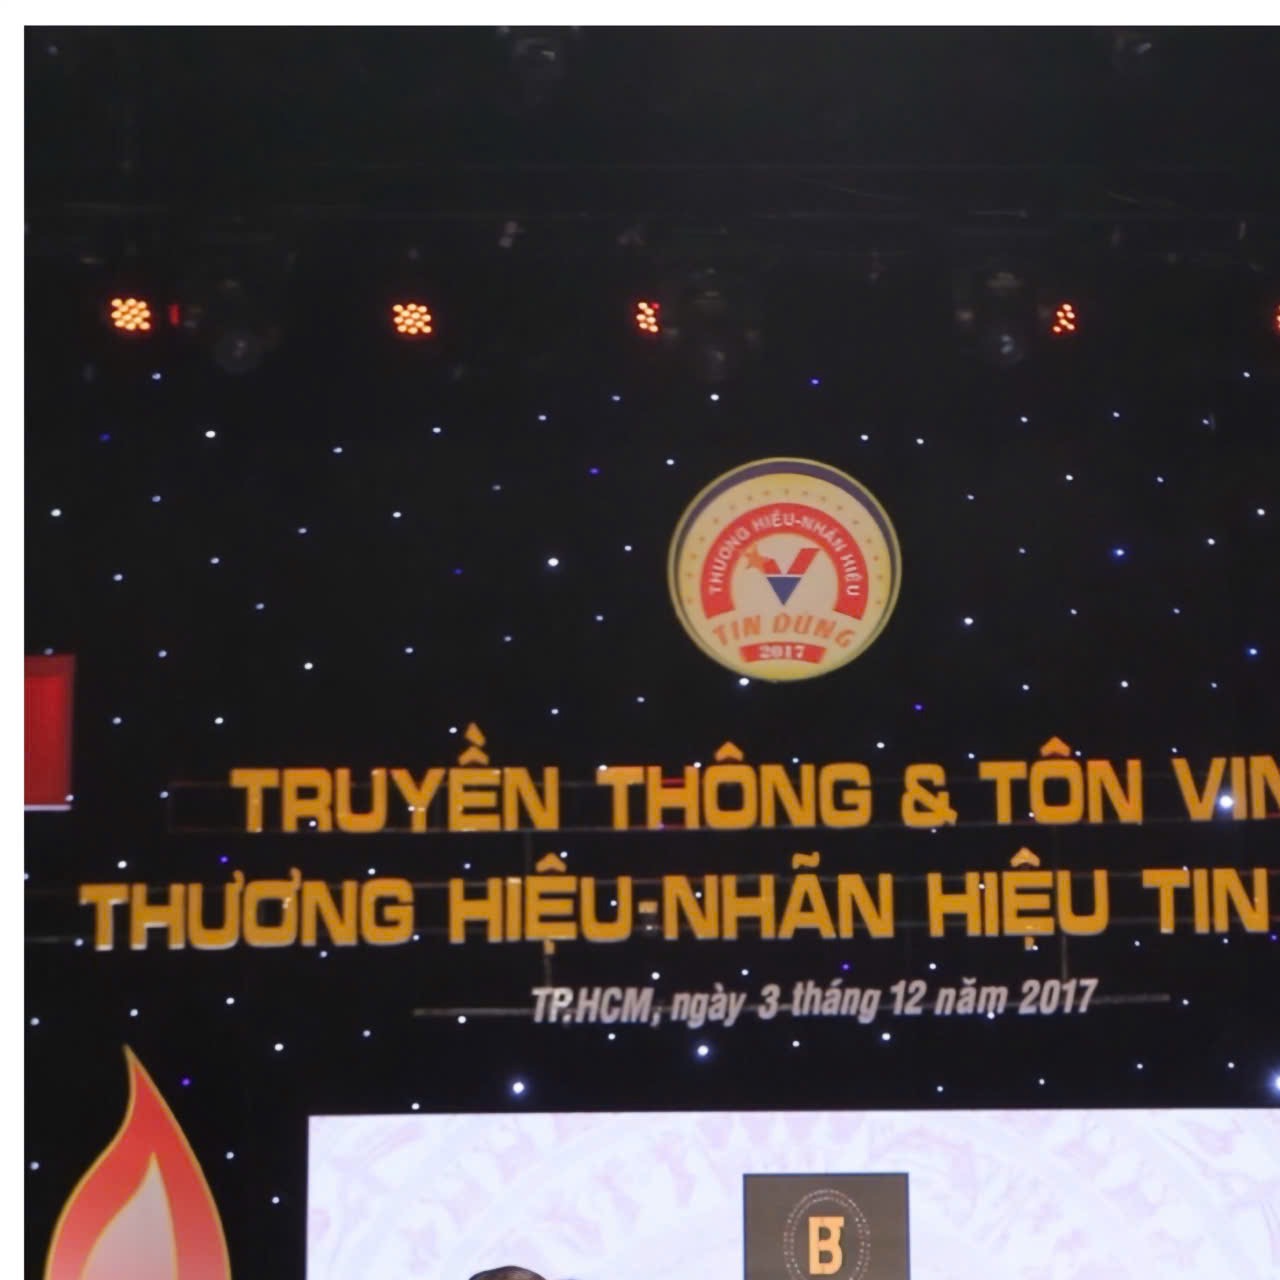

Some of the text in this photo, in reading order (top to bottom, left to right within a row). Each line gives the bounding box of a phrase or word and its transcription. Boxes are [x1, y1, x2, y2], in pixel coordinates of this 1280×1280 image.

[712, 614, 761, 646] TIN
[229, 723, 561, 833] TRUYỀN
[596, 741, 873, 829] THÔNG
[902, 763, 957, 828] &
[979, 736, 1143, 825] TÔN
[79, 867, 414, 951] THƯƠNG
[927, 847, 1109, 951] HIỆU
[1142, 868, 1269, 933] TIN
[671, 983, 746, 1026] ngày
[758, 985, 781, 1019] 3
[793, 978, 880, 1024] tháng
[890, 980, 927, 1016] 12
[934, 978, 1007, 1015] năm
[1018, 978, 1098, 1014] 2017
